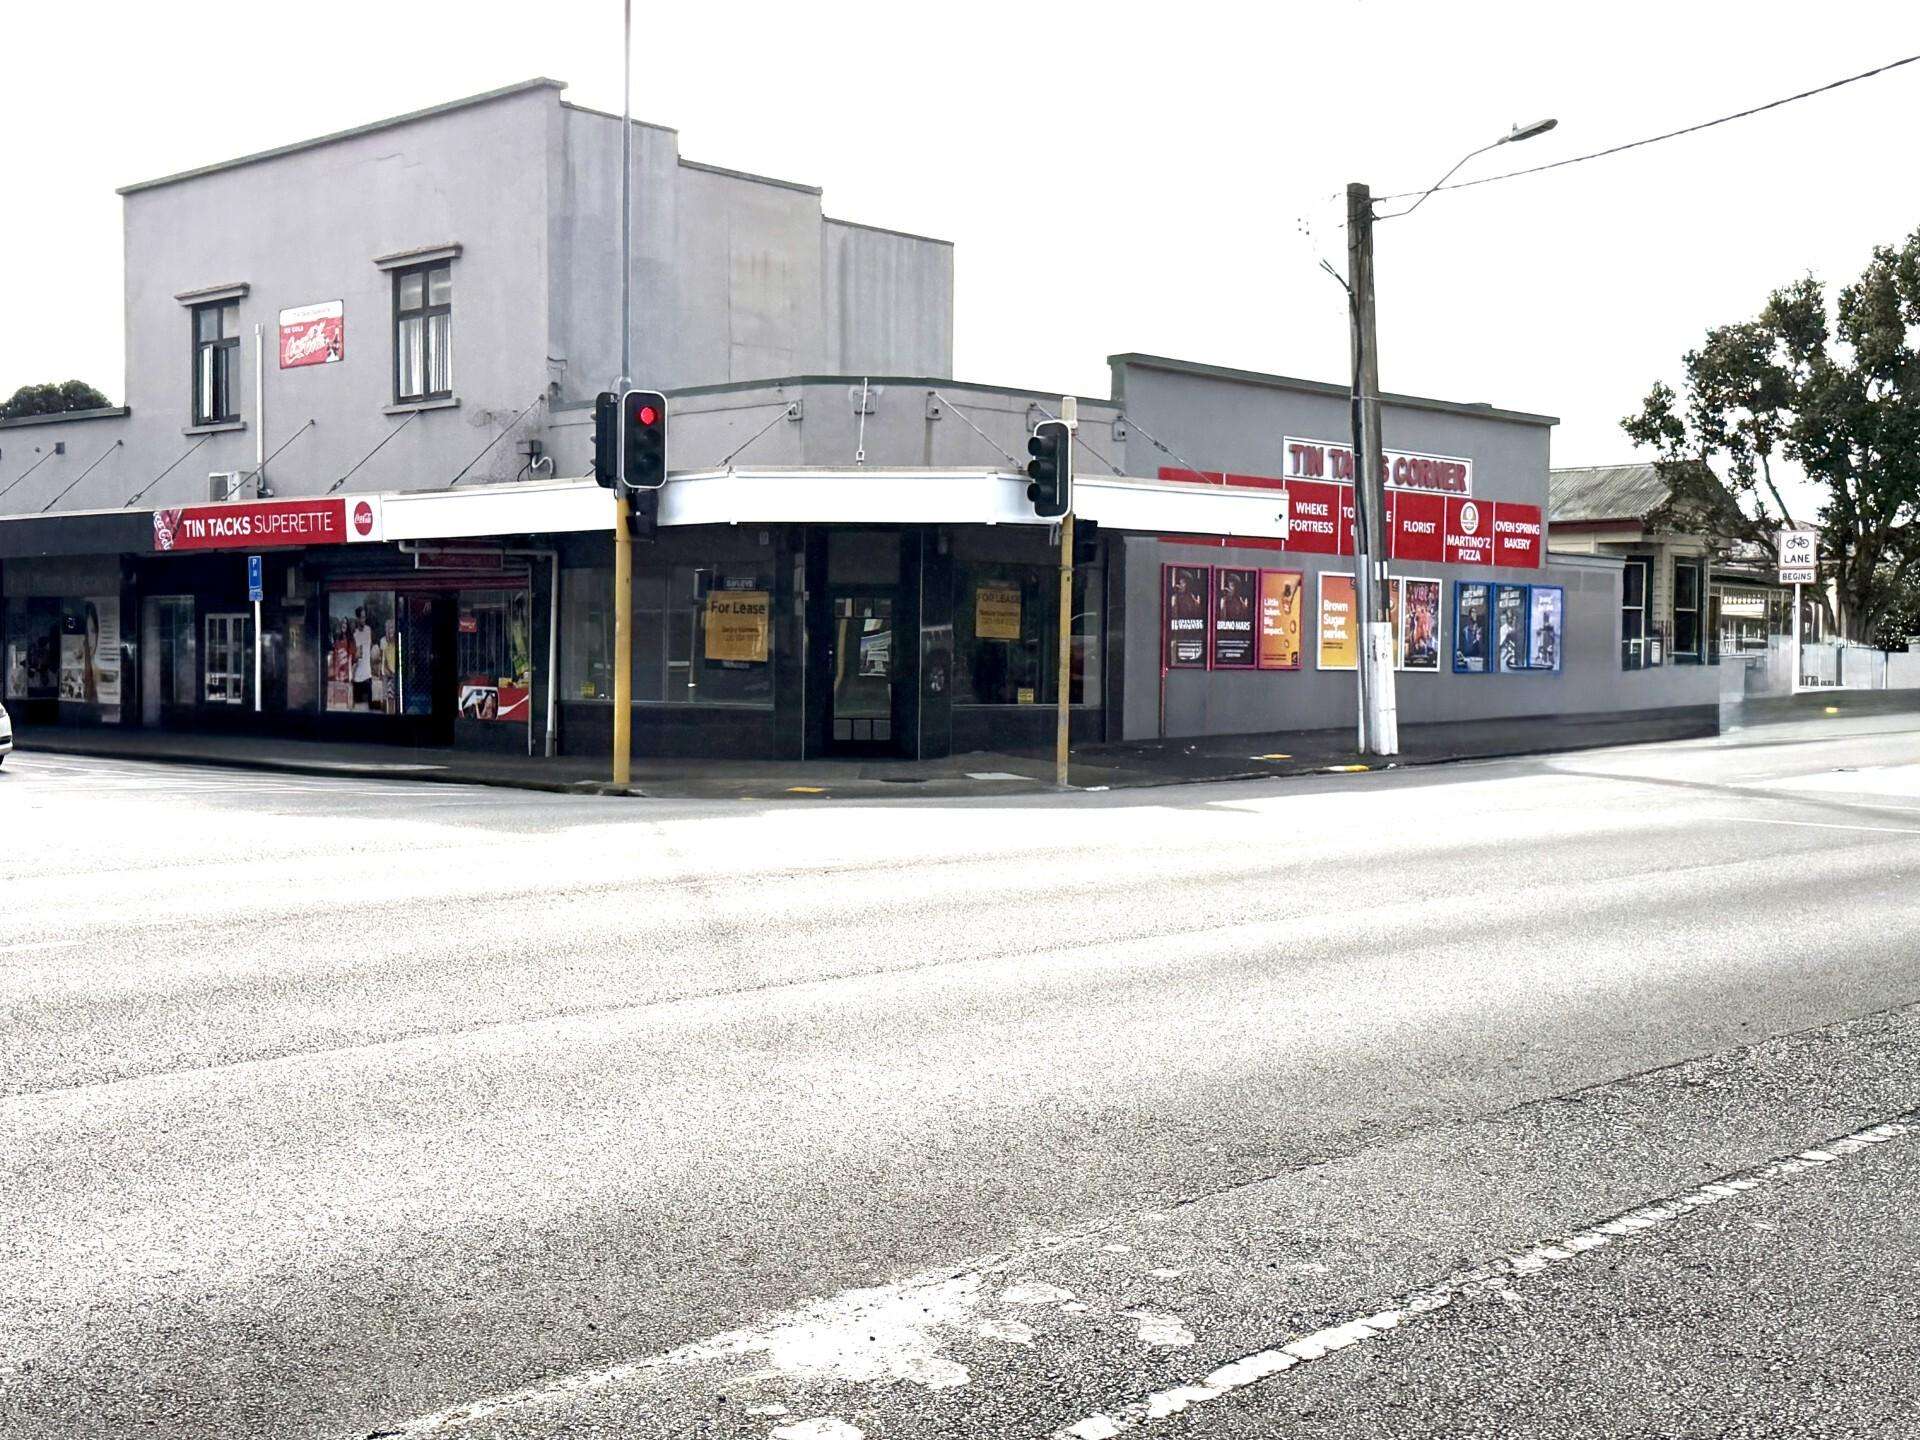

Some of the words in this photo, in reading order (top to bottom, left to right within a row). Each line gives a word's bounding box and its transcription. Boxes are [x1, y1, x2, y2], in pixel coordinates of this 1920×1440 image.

[1289, 443, 1324, 476] TIN
[1393, 456, 1466, 492] CORNER
[1296, 502, 1328, 516] WHEKE
[184, 519, 206, 538] TIN
[208, 516, 251, 537] TACKS
[254, 512, 333, 533] SUPERETTE
[1289, 518, 1333, 534] FORTRESS
[1403, 520, 1435, 535] FLORIST
[1495, 520, 1515, 532] OVEN
[1516, 522, 1540, 536] SPRING
[1447, 534, 1491, 549] MARTINO'Z
[1504, 537, 1531, 550] BAKERY
[1458, 549, 1481, 562] PIZZA
[1784, 554, 1810, 564] LANE
[1782, 572, 1812, 581] BEGINS
[711, 600, 730, 614] For
[733, 601, 766, 615] Lease
[1323, 599, 1348, 612] Brown
[1216, 620, 1235, 631] BRUNO
[1235, 621, 1251, 631] MARS
[1323, 613, 1346, 630] Sugar
